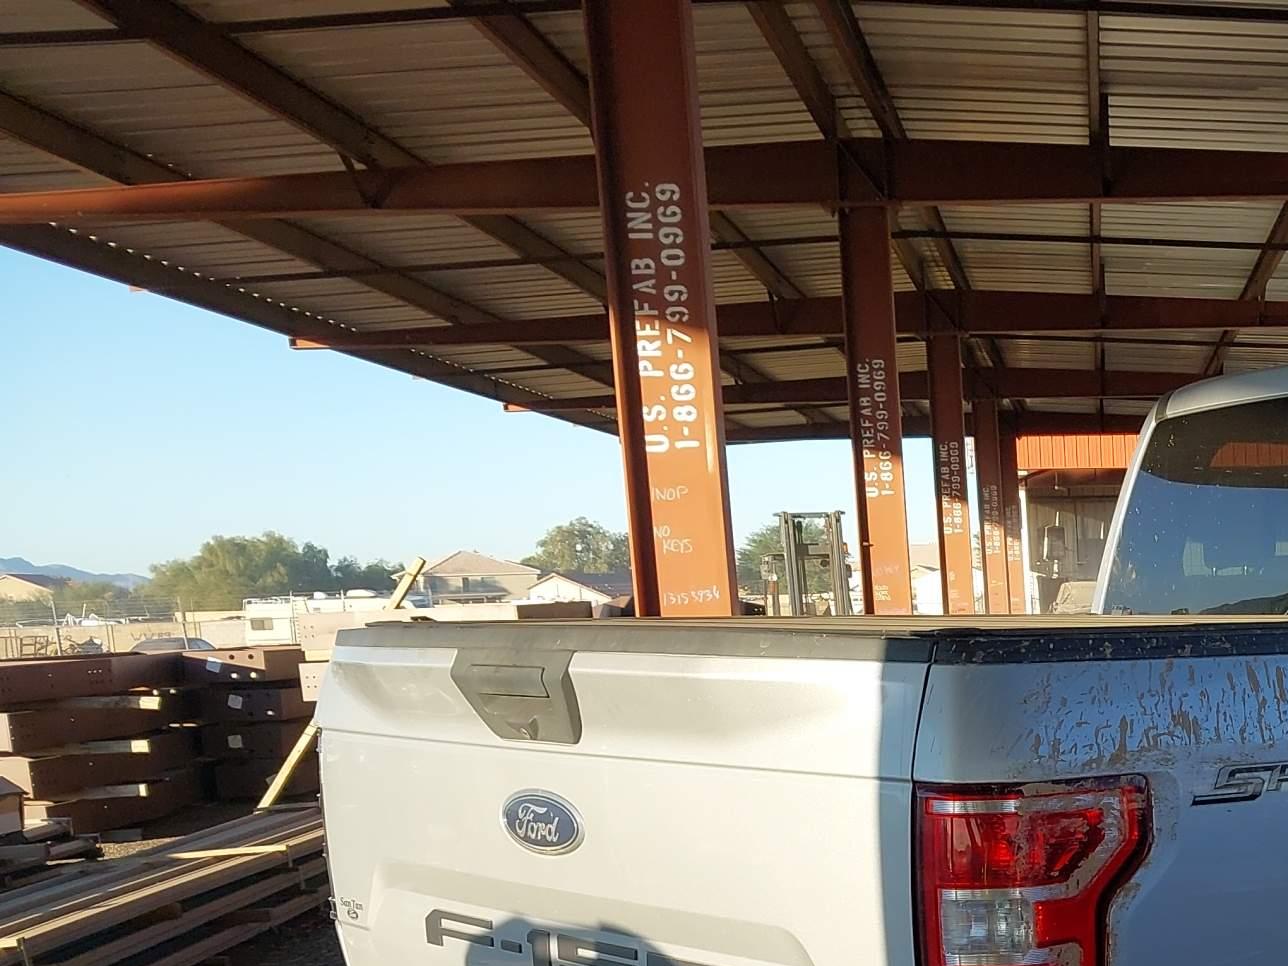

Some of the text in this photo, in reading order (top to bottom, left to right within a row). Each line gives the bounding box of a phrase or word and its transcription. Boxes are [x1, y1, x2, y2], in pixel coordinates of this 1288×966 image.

[625, 182, 670, 453] U.S. PREFAB INC.
[655, 183, 700, 449] 1-866-799-0969
[857, 358, 880, 498] U.S. PREFAB INC.
[871, 359, 895, 496] 1-866-799-0969
[653, 525, 672, 538] NO
[663, 538, 693, 554] KEYS
[515, 803, 560, 842] Ford
